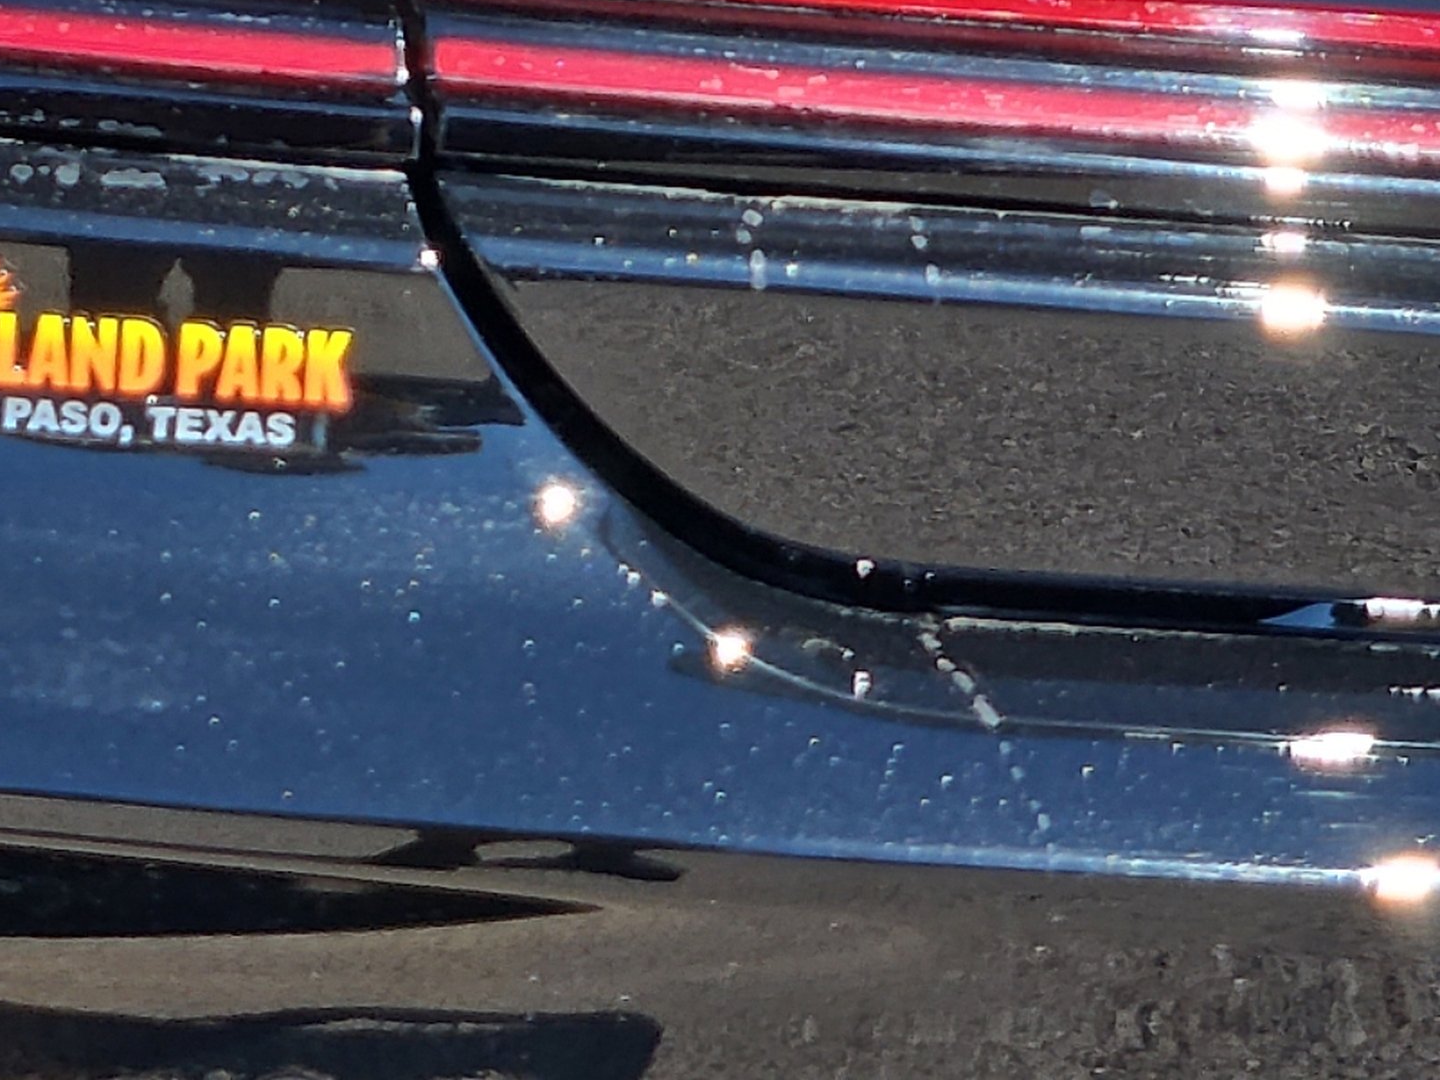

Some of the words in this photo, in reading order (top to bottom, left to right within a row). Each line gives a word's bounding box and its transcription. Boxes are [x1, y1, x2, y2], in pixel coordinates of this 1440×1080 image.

[175, 318, 355, 412] PARK
[3, 395, 134, 445] PASO,
[146, 405, 297, 447] TEXAS
